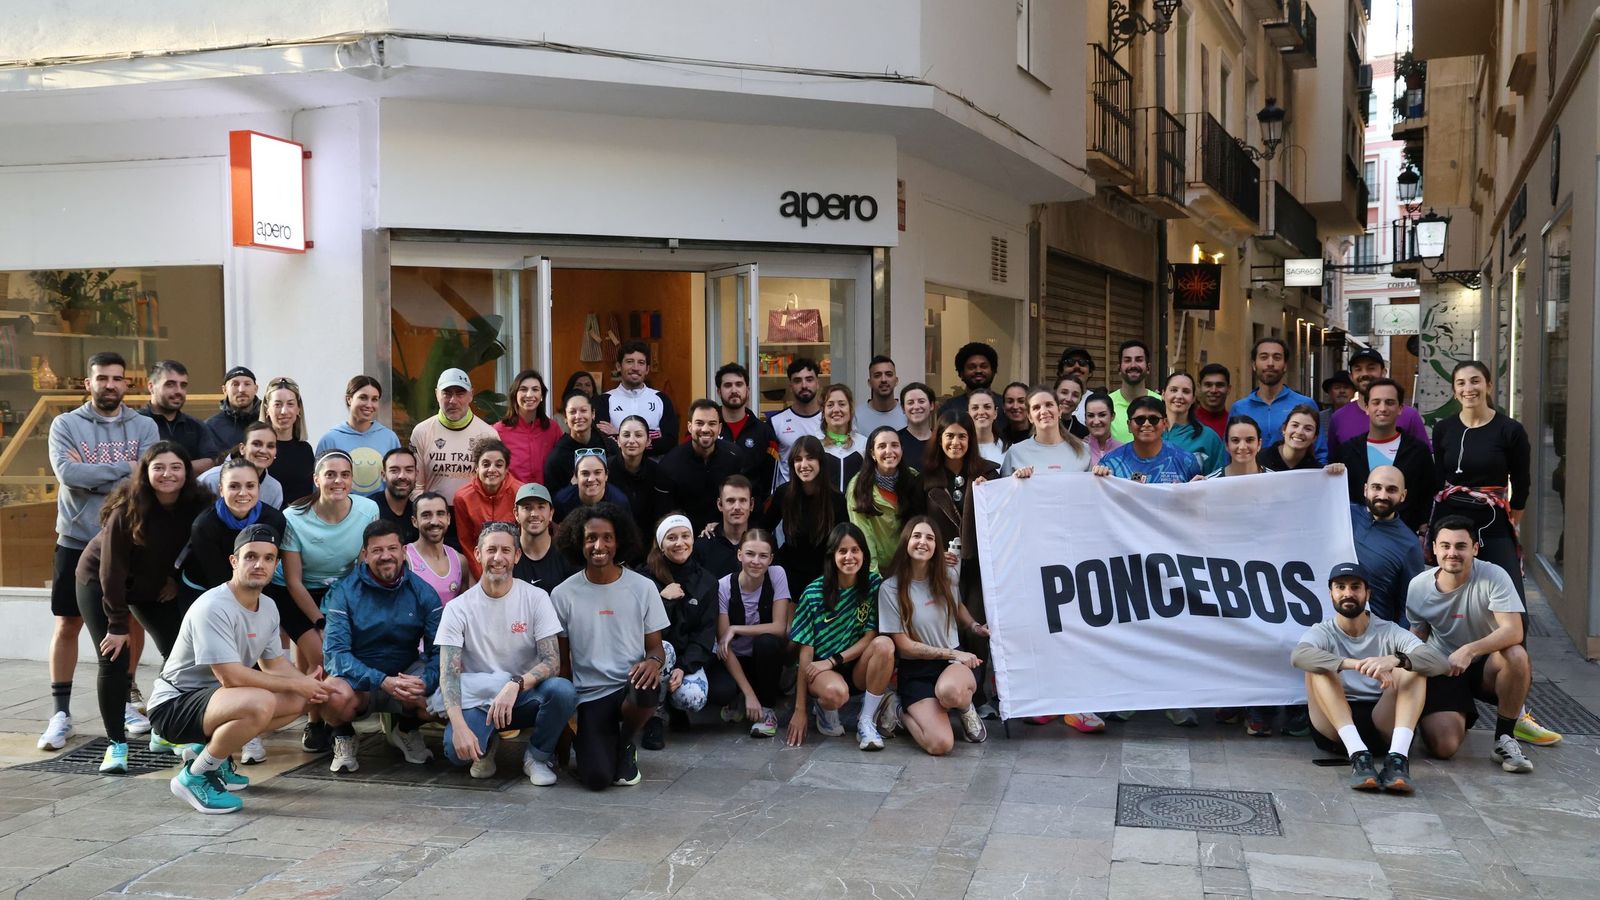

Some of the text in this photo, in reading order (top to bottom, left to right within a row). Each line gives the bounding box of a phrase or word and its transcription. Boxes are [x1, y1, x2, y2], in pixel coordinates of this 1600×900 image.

[780, 191, 878, 227] apero
[256, 221, 291, 240] apero
[429, 452, 476, 463] VIII TRAI
[1040, 553, 1324, 634] PONCEBOS
